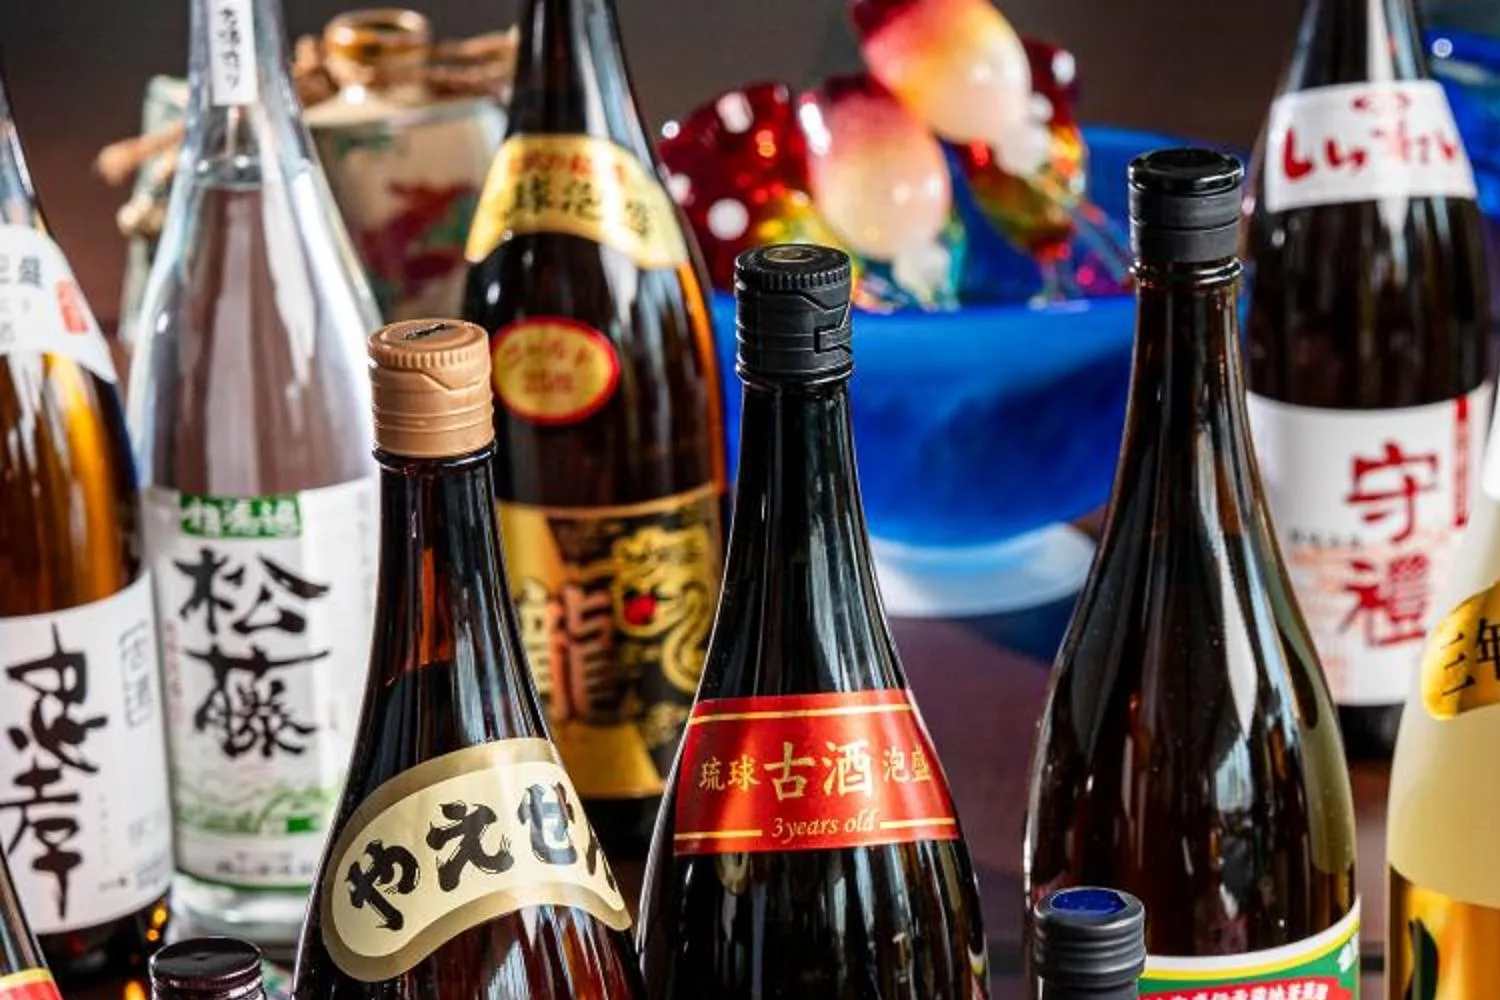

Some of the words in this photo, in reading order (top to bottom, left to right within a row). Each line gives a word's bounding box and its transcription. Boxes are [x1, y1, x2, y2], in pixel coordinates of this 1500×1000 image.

[699, 753, 761, 792] 琉球
[764, 740, 873, 802] 古酒
[882, 745, 932, 784] 泡盛
